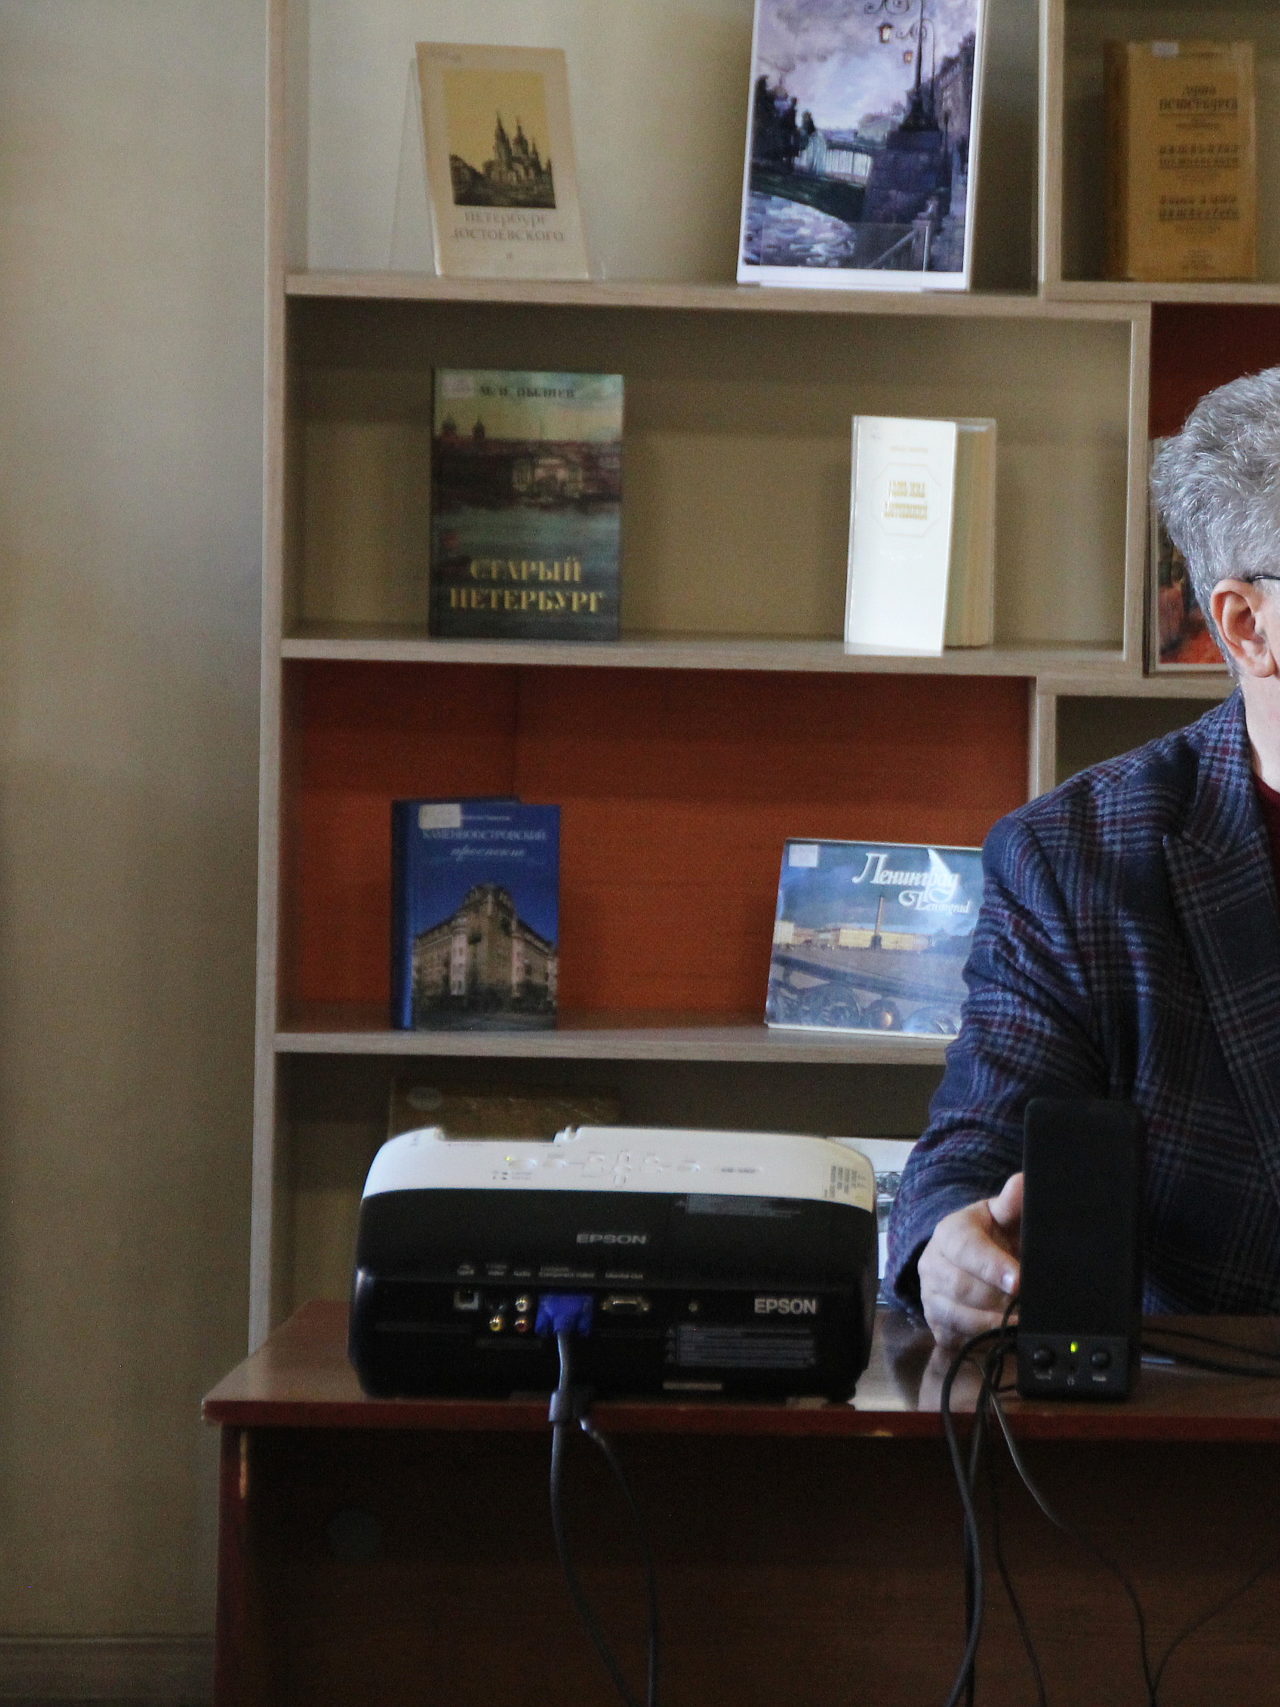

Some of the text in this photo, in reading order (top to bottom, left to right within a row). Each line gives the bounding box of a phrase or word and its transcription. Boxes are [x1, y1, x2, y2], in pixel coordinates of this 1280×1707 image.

[470, 556, 583, 582] СТАРЫЙ
[450, 587, 606, 613] ПЕТЕРБУРГ
[576, 1233, 647, 1245] EPSON
[754, 1298, 817, 1315] EPSON
